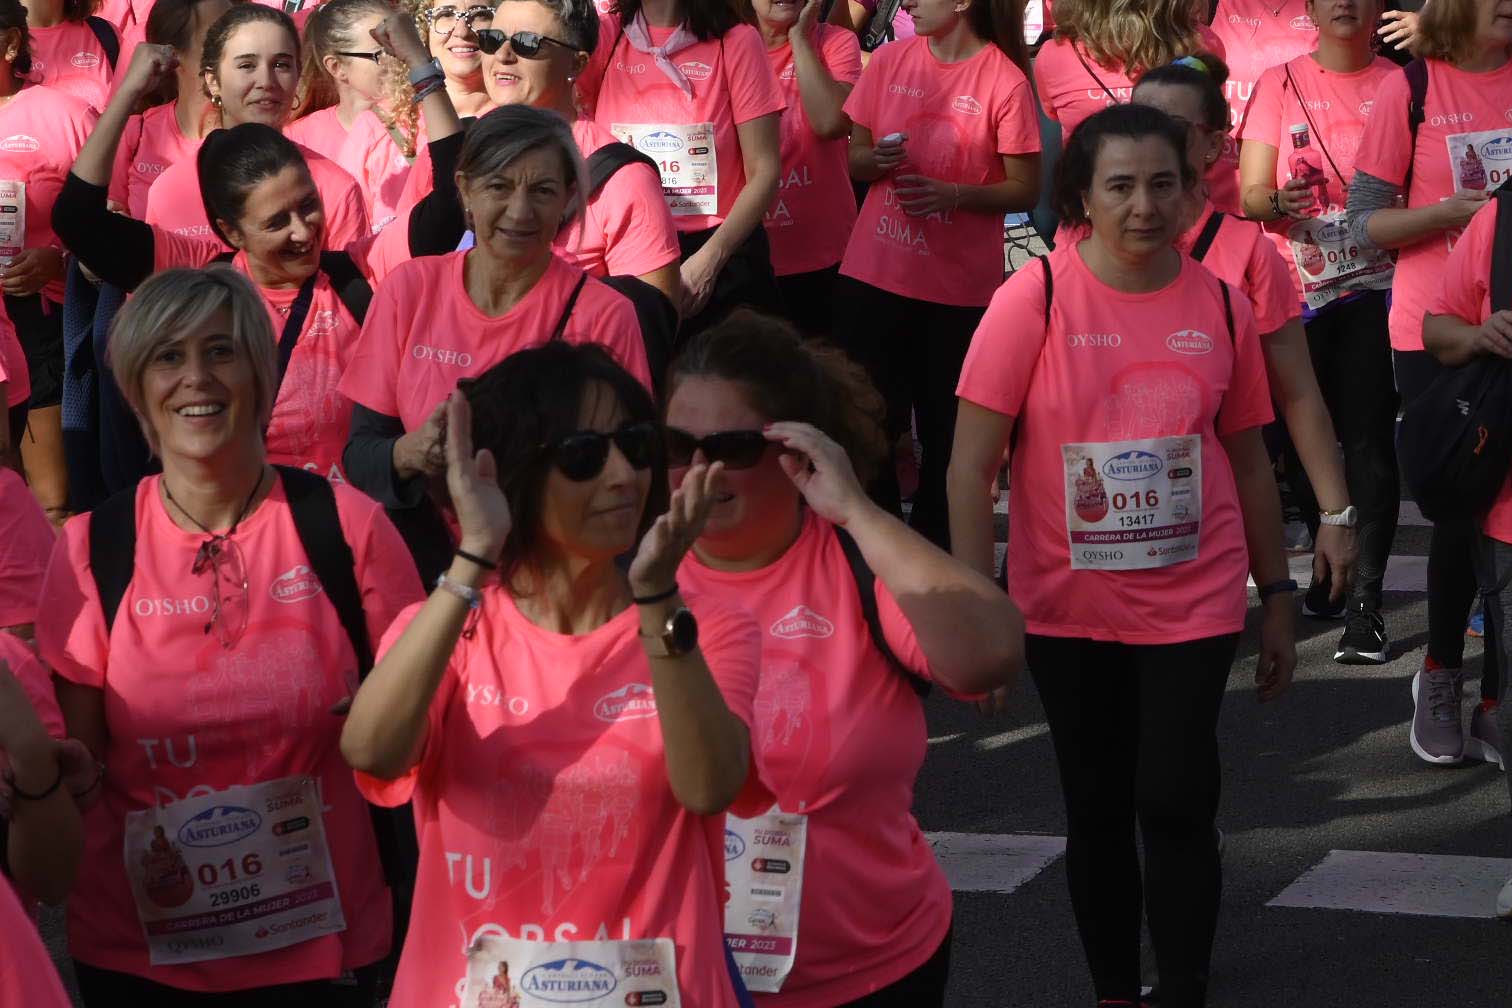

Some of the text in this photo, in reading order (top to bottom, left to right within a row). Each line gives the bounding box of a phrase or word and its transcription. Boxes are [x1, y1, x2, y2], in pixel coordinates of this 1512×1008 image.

[889, 84, 924, 97] OYSHO
[1431, 112, 1473, 127] OYSHO
[876, 216, 929, 248] SUMA
[1327, 246, 1358, 263] 016
[1068, 334, 1122, 347] OYSHO
[412, 344, 472, 367] OYSHO
[1107, 460, 1160, 475] ASTURIANA
[1112, 490, 1160, 510] 016
[1119, 514, 1155, 527] 13417
[1084, 533, 1121, 542] CARRERA
[1123, 532, 1135, 540] DE
[1136, 531, 1147, 539] LA
[1149, 528, 1174, 538] MUJER
[1083, 550, 1124, 561] OYSHO
[135, 596, 209, 617] OYSHO
[776, 621, 833, 637] ASTURIANA
[137, 739, 198, 768] TU
[184, 818, 256, 843] ASTURIANA
[753, 836, 790, 847] SUMA
[198, 853, 262, 885] 016
[445, 852, 491, 899] TU
[210, 884, 261, 907] 29906
[220, 913, 234, 922] DE
[236, 909, 250, 919] LA
[253, 898, 290, 914] MUJER
[270, 911, 328, 935] Santander
[751, 940, 776, 951] 2023
[625, 965, 661, 977] SUMA
[528, 976, 609, 992] ASTURIANA
